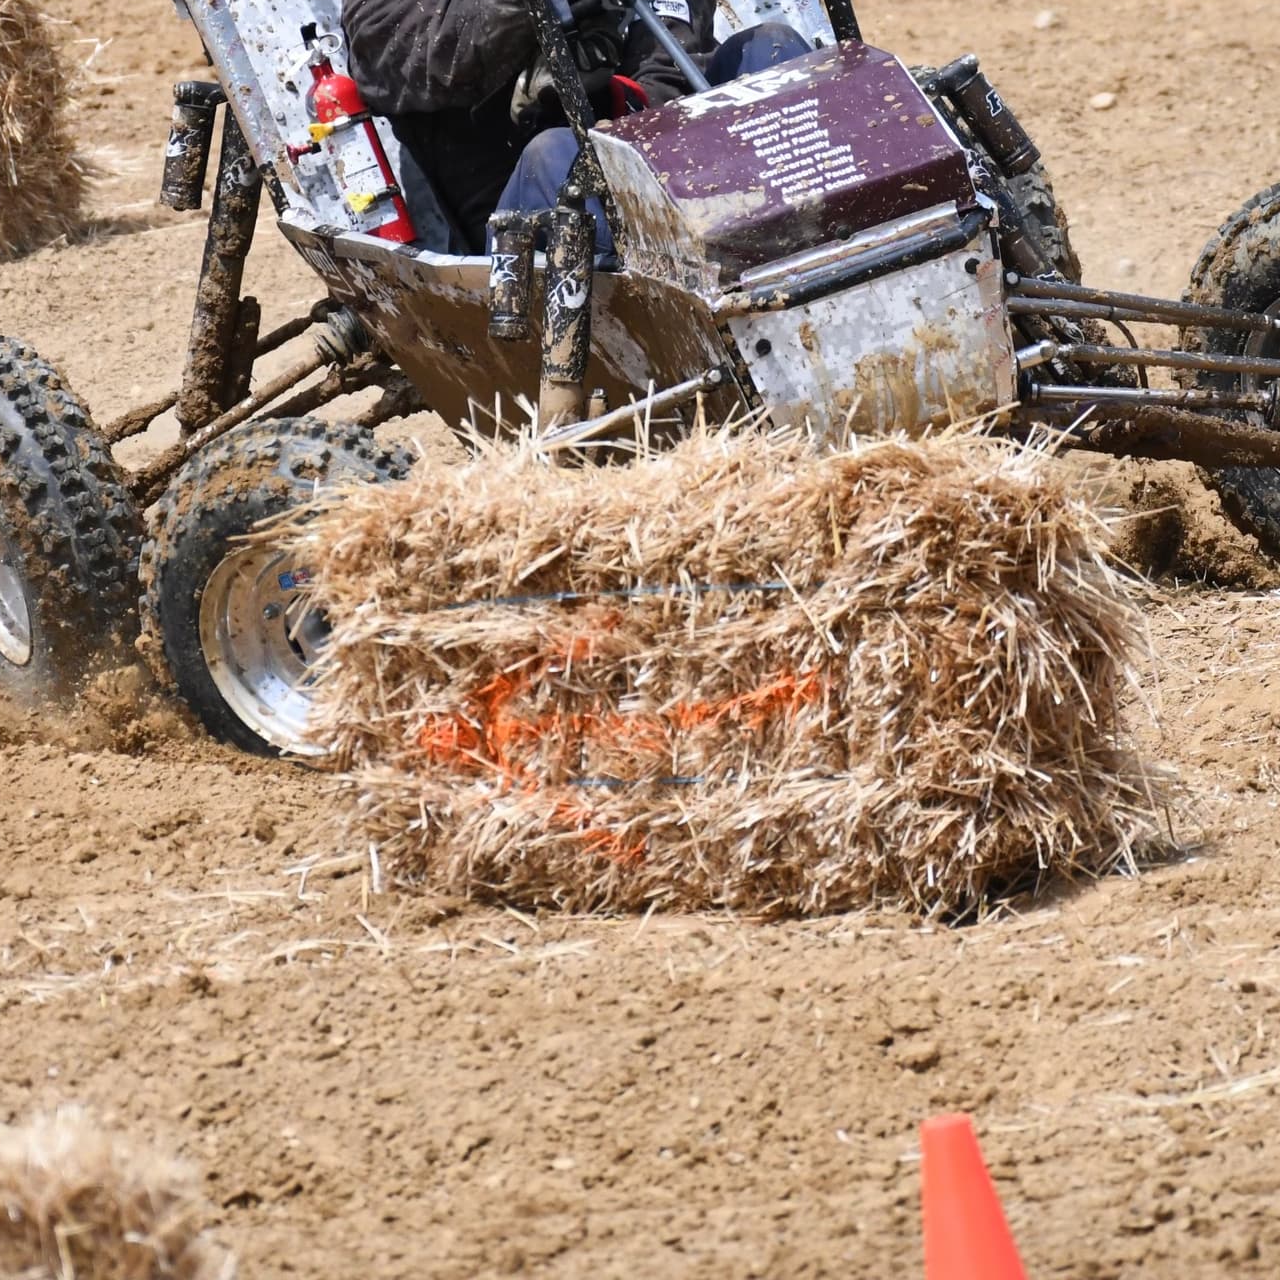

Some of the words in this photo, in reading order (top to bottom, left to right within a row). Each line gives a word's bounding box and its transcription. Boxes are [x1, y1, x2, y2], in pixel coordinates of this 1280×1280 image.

[781, 98, 819, 115] Family
[780, 121, 818, 138] Family
[791, 129, 829, 146] Family
[792, 140, 830, 157] Family
[814, 144, 851, 161] Family
[816, 154, 854, 171] Fmily
[781, 176, 823, 195] Andew
